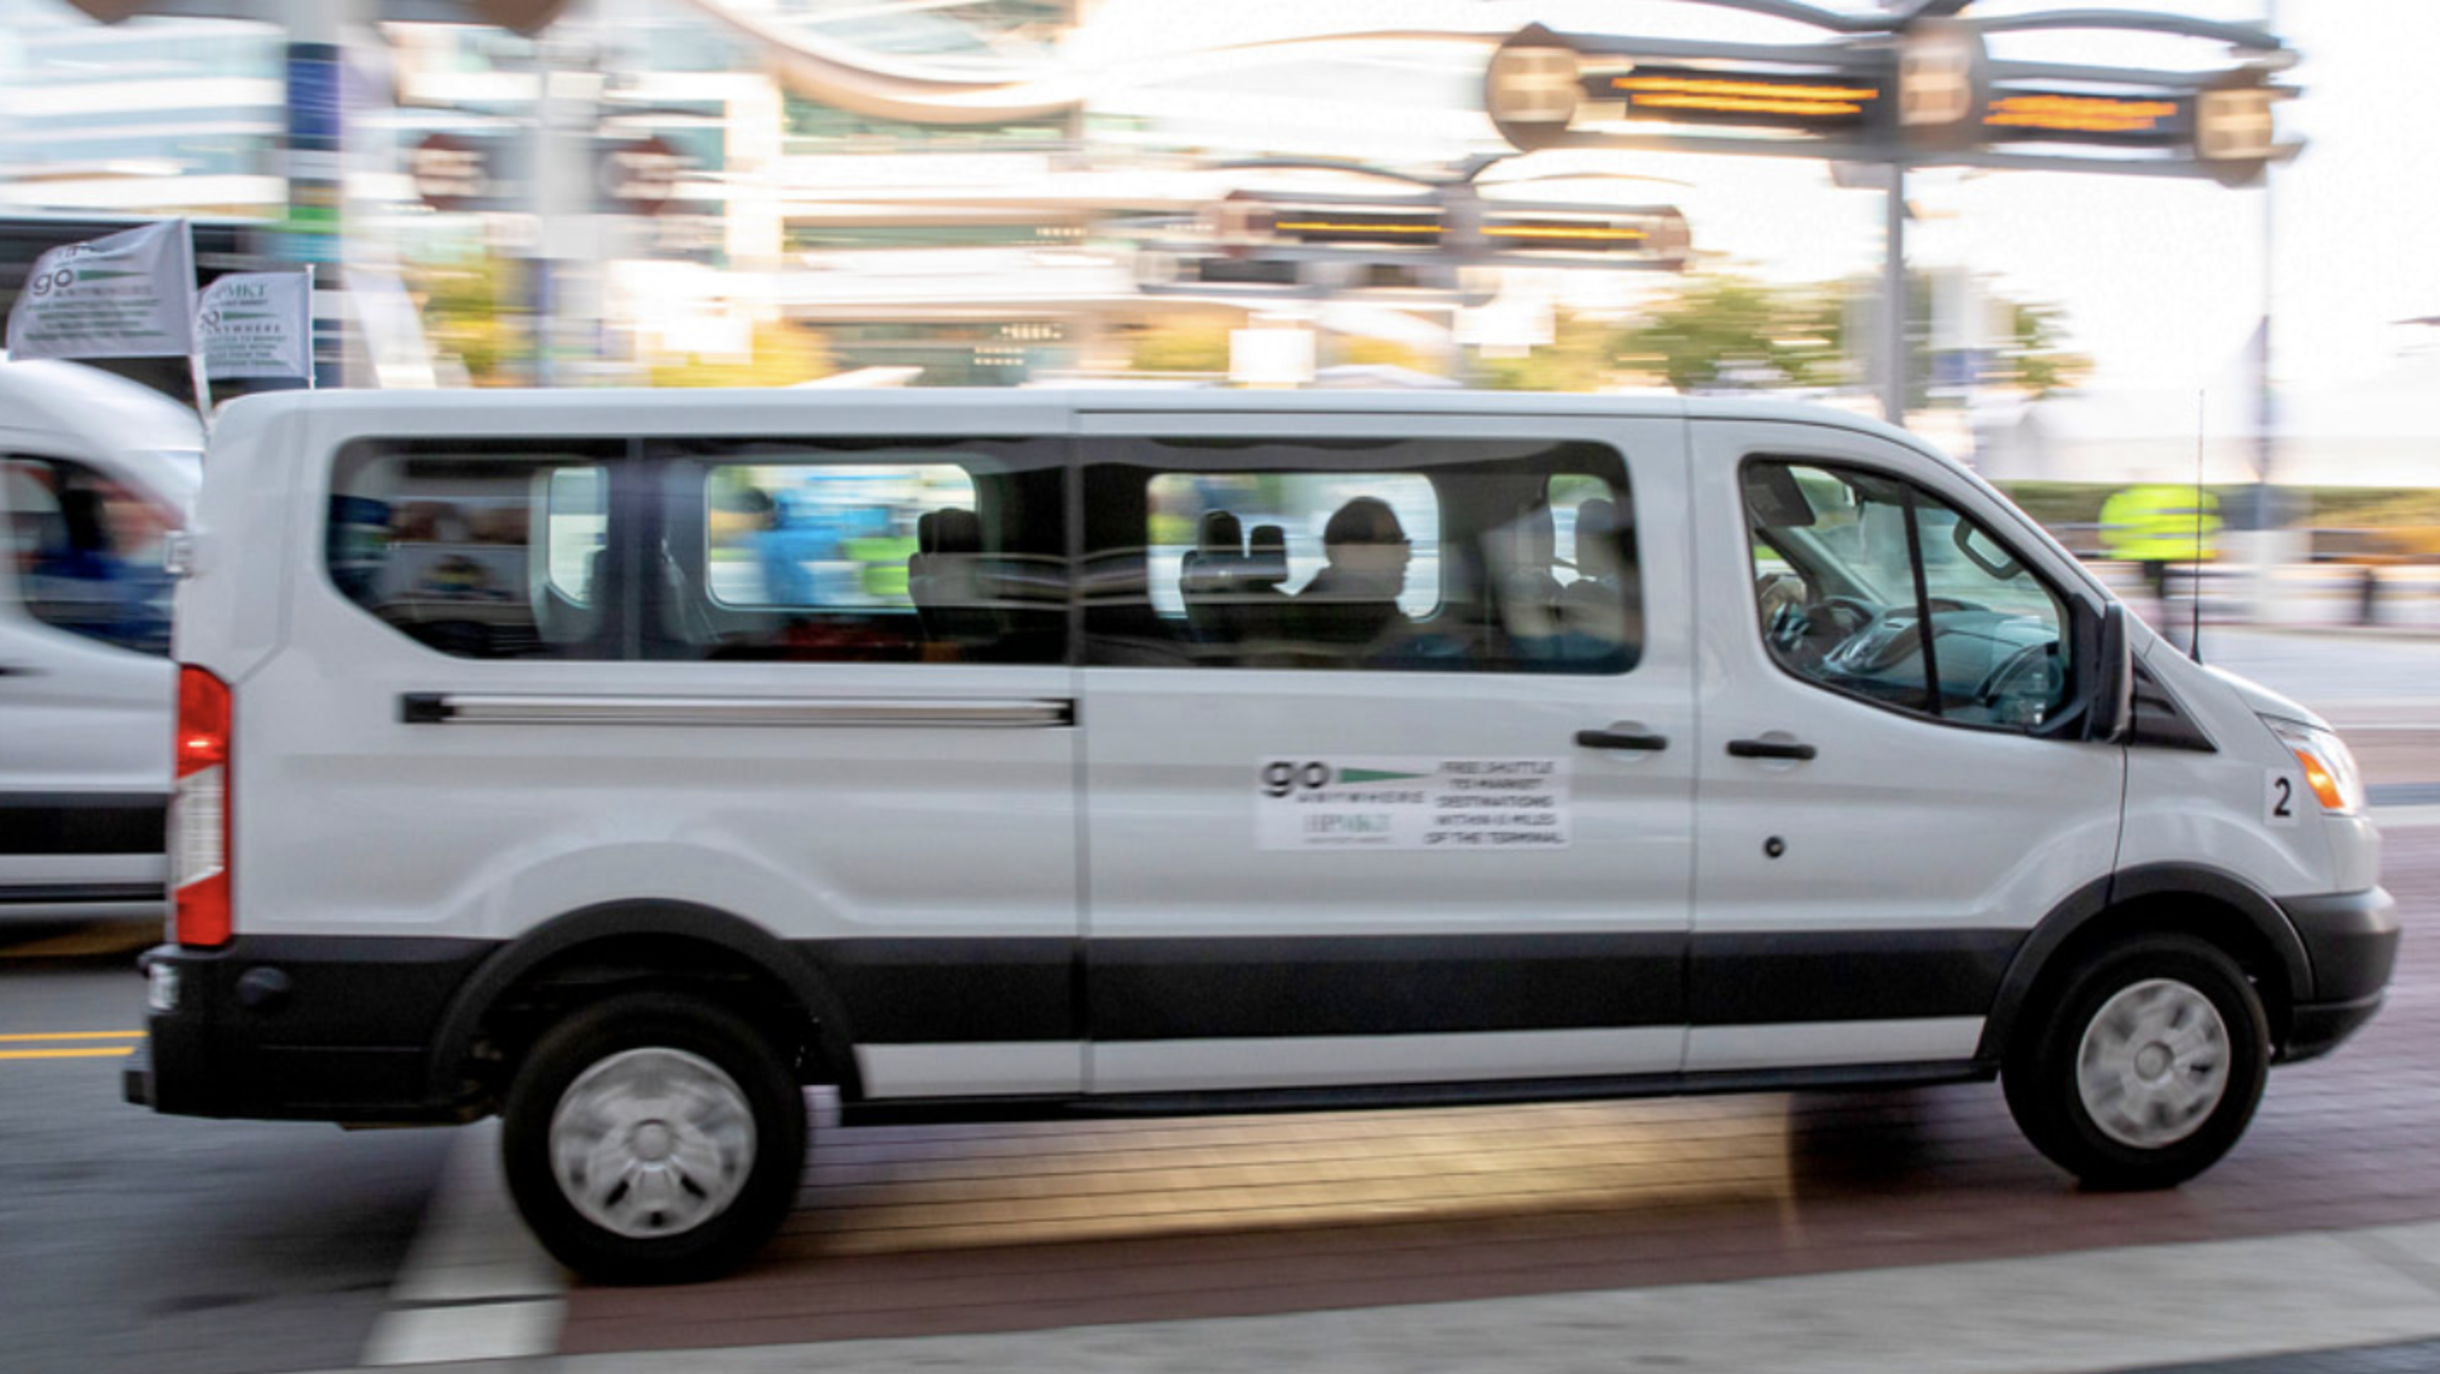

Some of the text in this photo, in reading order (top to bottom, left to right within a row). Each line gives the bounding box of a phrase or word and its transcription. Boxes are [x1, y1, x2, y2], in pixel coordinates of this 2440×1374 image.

[33, 268, 74, 297] go
[1260, 760, 1332, 798] go
[2273, 776, 2292, 818] 2
